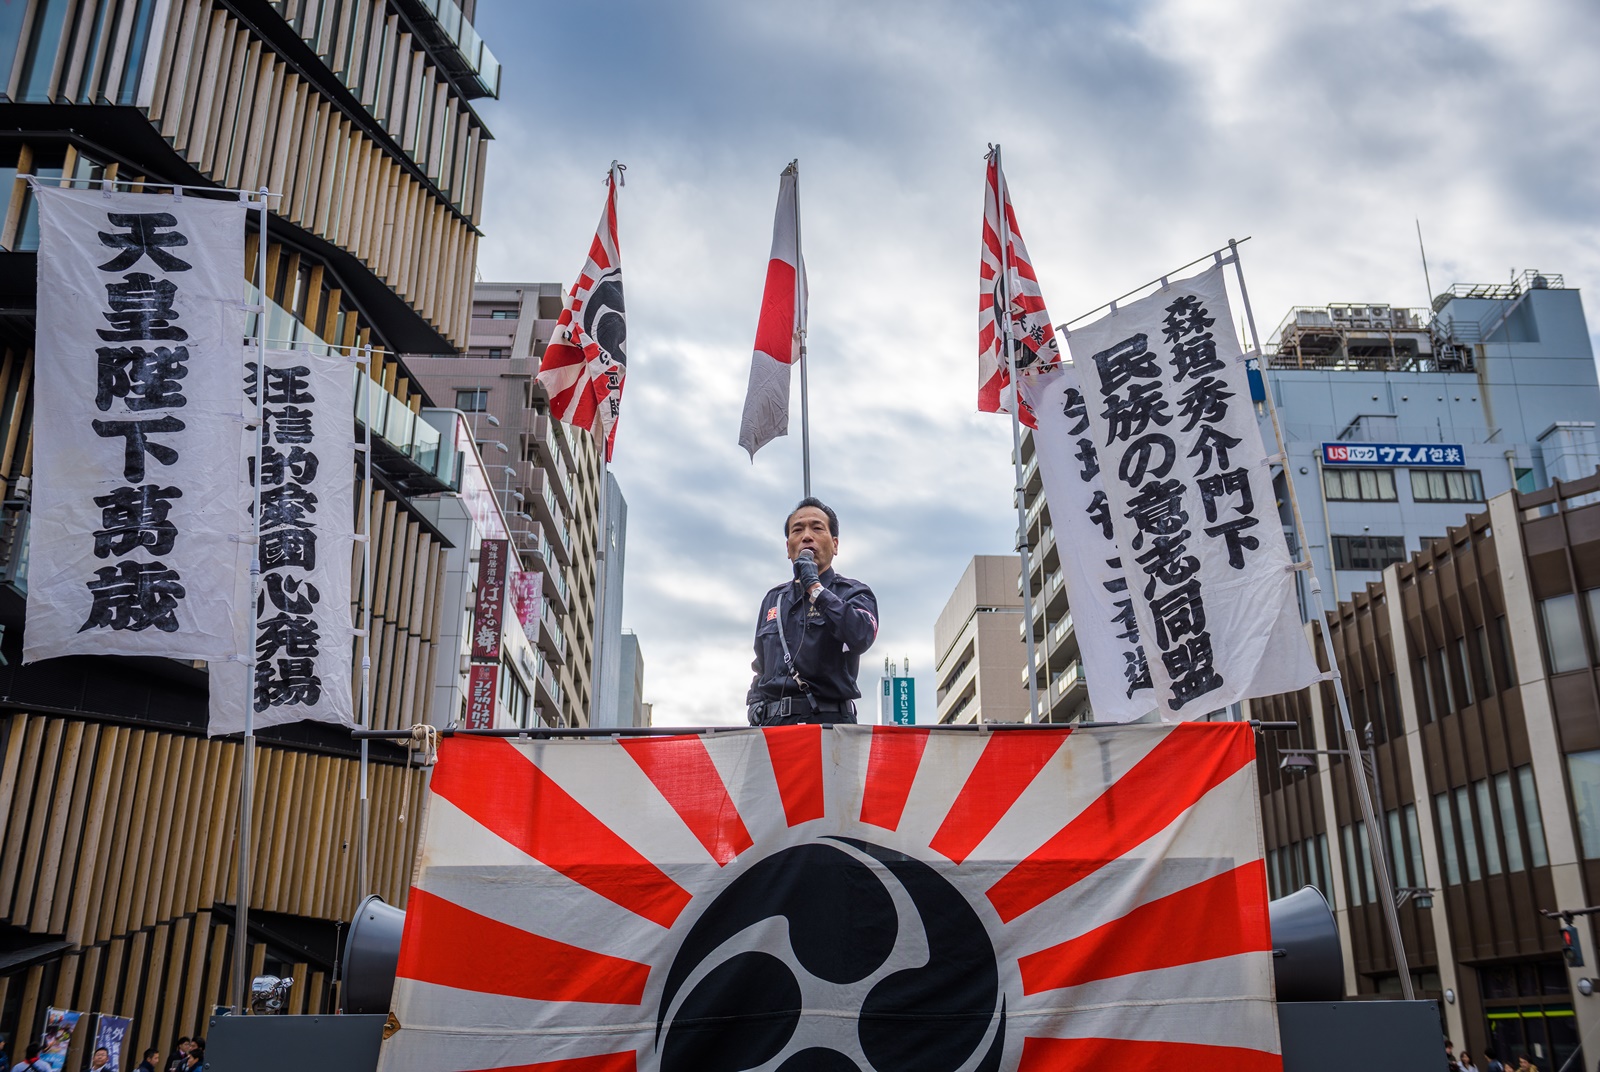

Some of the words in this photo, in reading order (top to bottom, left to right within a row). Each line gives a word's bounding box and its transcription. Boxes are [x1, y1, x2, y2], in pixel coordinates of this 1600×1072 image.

[1162, 295, 1260, 569] 森垣秀介門下
[1379, 447, 1461, 462] ウスイ包装
[1092, 333, 1224, 711] 民族の意志同盟
[475, 586, 500, 653] はなの舞
[471, 680, 484, 729] コミックカフ
[479, 680, 492, 729] インターネット
